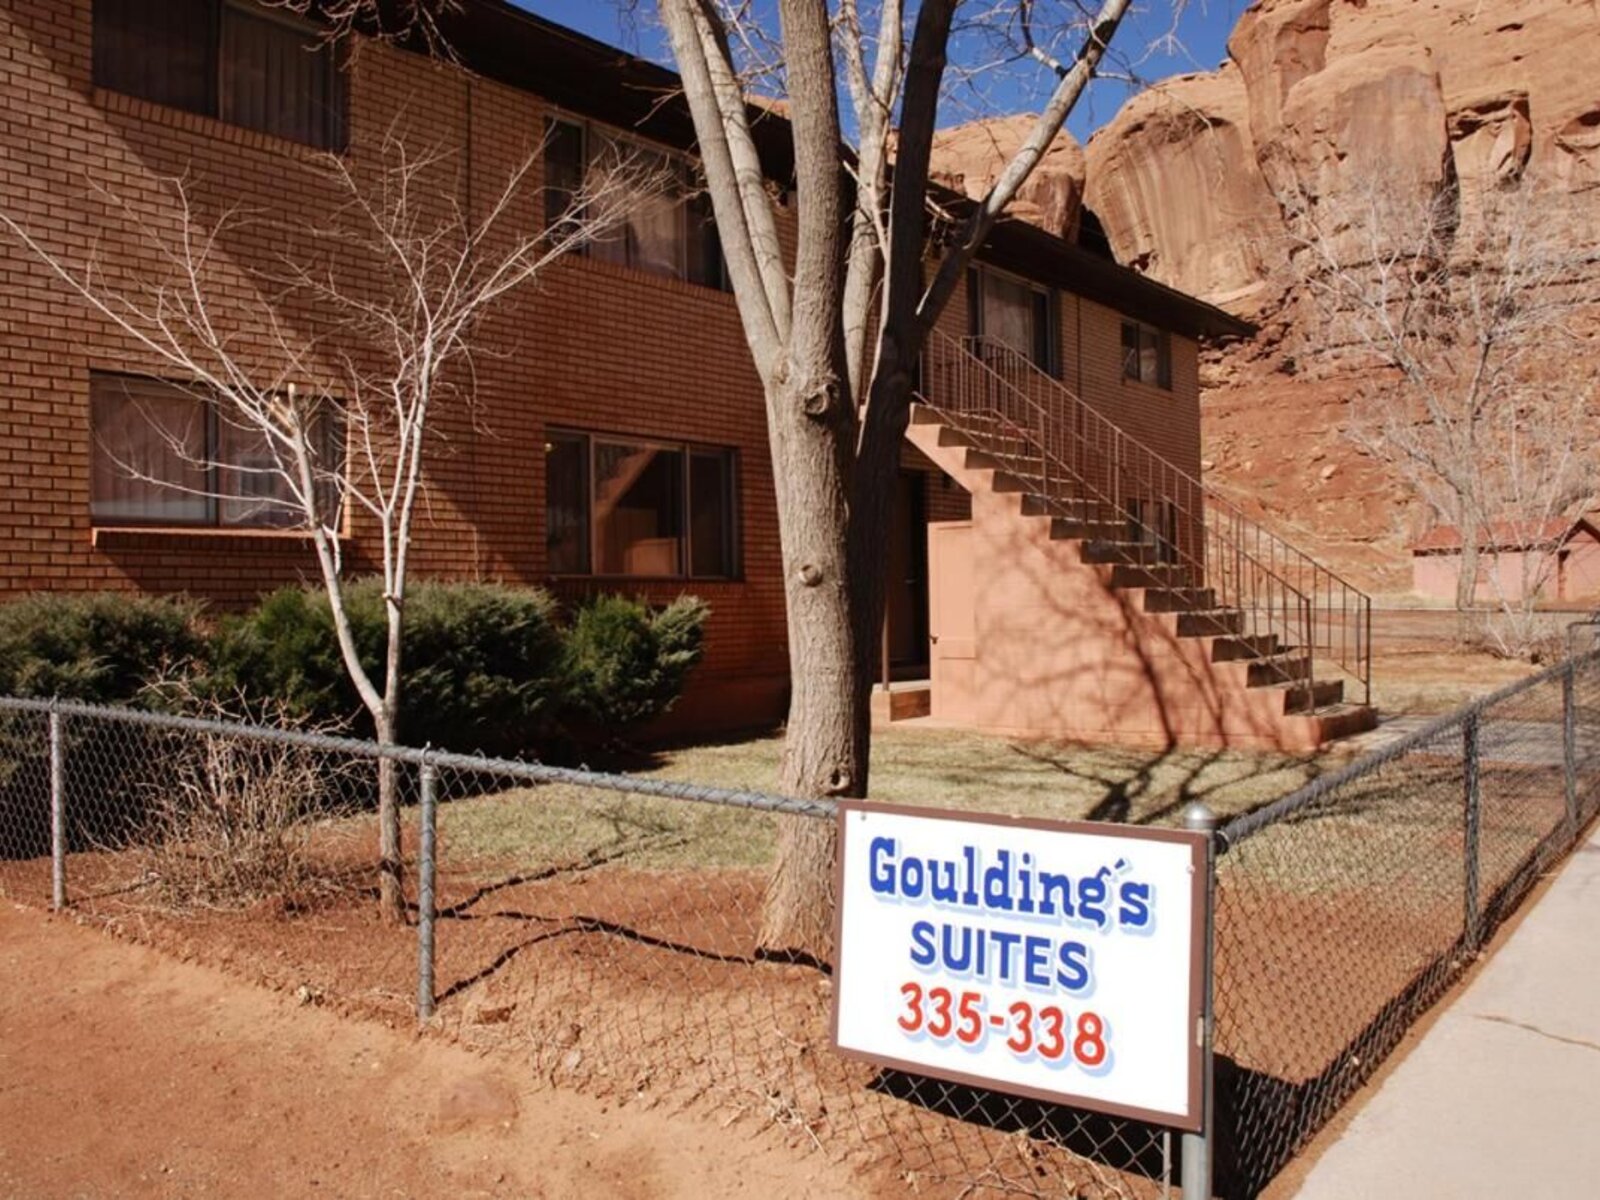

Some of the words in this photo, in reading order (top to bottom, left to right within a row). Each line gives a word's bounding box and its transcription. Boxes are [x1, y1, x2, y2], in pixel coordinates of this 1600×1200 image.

[869, 836, 1149, 927] Goulding's
[910, 921, 1089, 990] SUITES
[897, 982, 1107, 1066] 335-338
